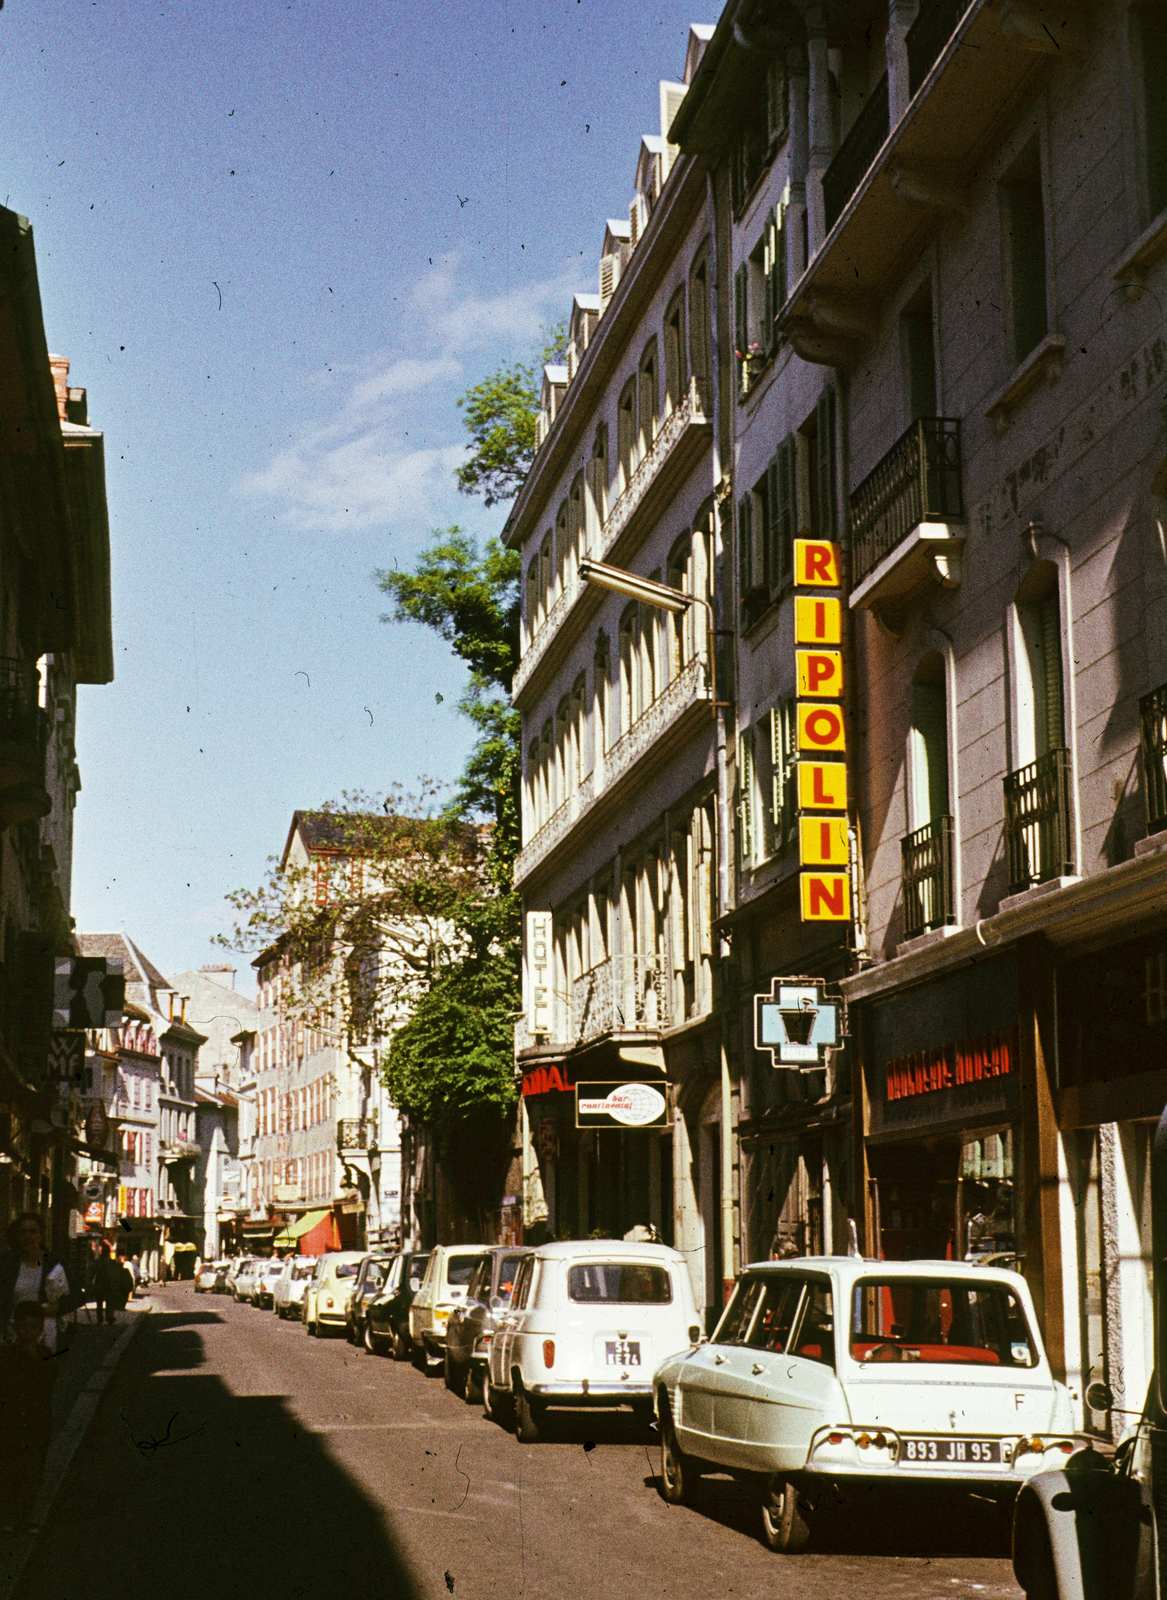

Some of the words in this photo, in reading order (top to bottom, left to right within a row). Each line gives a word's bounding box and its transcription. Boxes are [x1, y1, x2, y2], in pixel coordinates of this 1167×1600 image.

[804, 545, 844, 915] RIPOLIN
[533, 917, 548, 1031] HOTEL
[581, 1102, 633, 1110] continental
[612, 1094, 629, 1102] bar
[614, 1342, 630, 1353] 54
[1014, 1393, 1025, 1410] F
[906, 1441, 938, 1460] 893
[946, 1441, 966, 1461] JH
[971, 1443, 992, 1462] 95
